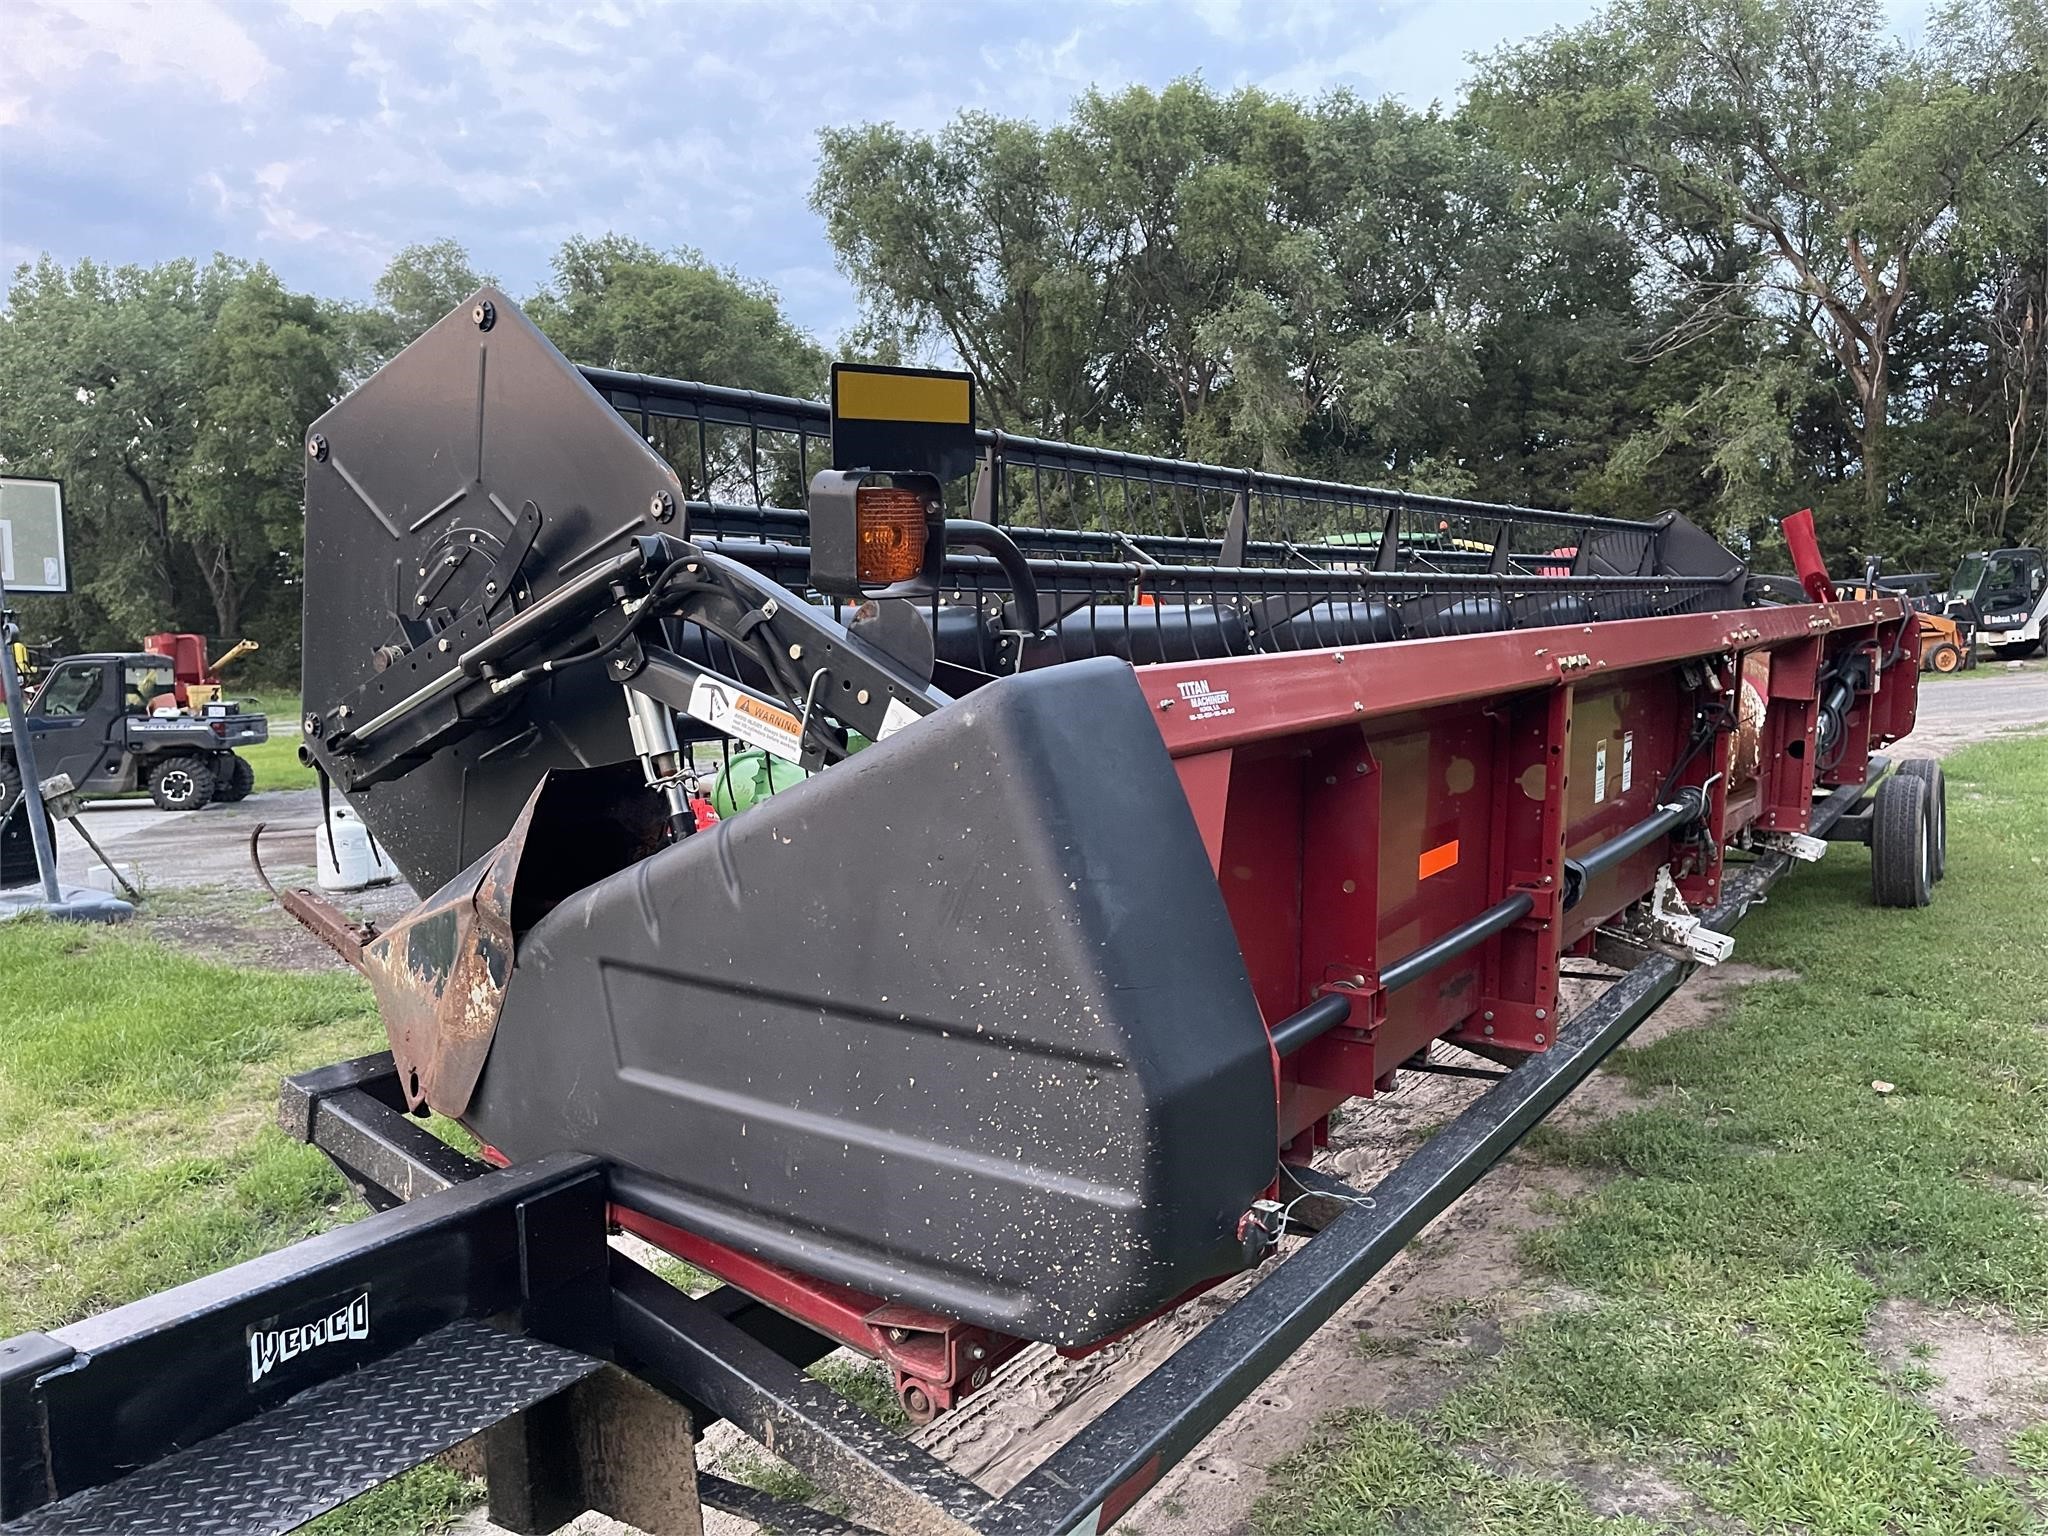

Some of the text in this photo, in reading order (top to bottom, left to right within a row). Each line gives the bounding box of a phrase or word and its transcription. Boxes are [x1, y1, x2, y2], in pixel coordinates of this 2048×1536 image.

[1177, 680, 1210, 697] TITAN
[1190, 693, 1230, 708] MACHINERY
[754, 706, 798, 734] WARNING
[250, 1291, 369, 1384] WEMCO
